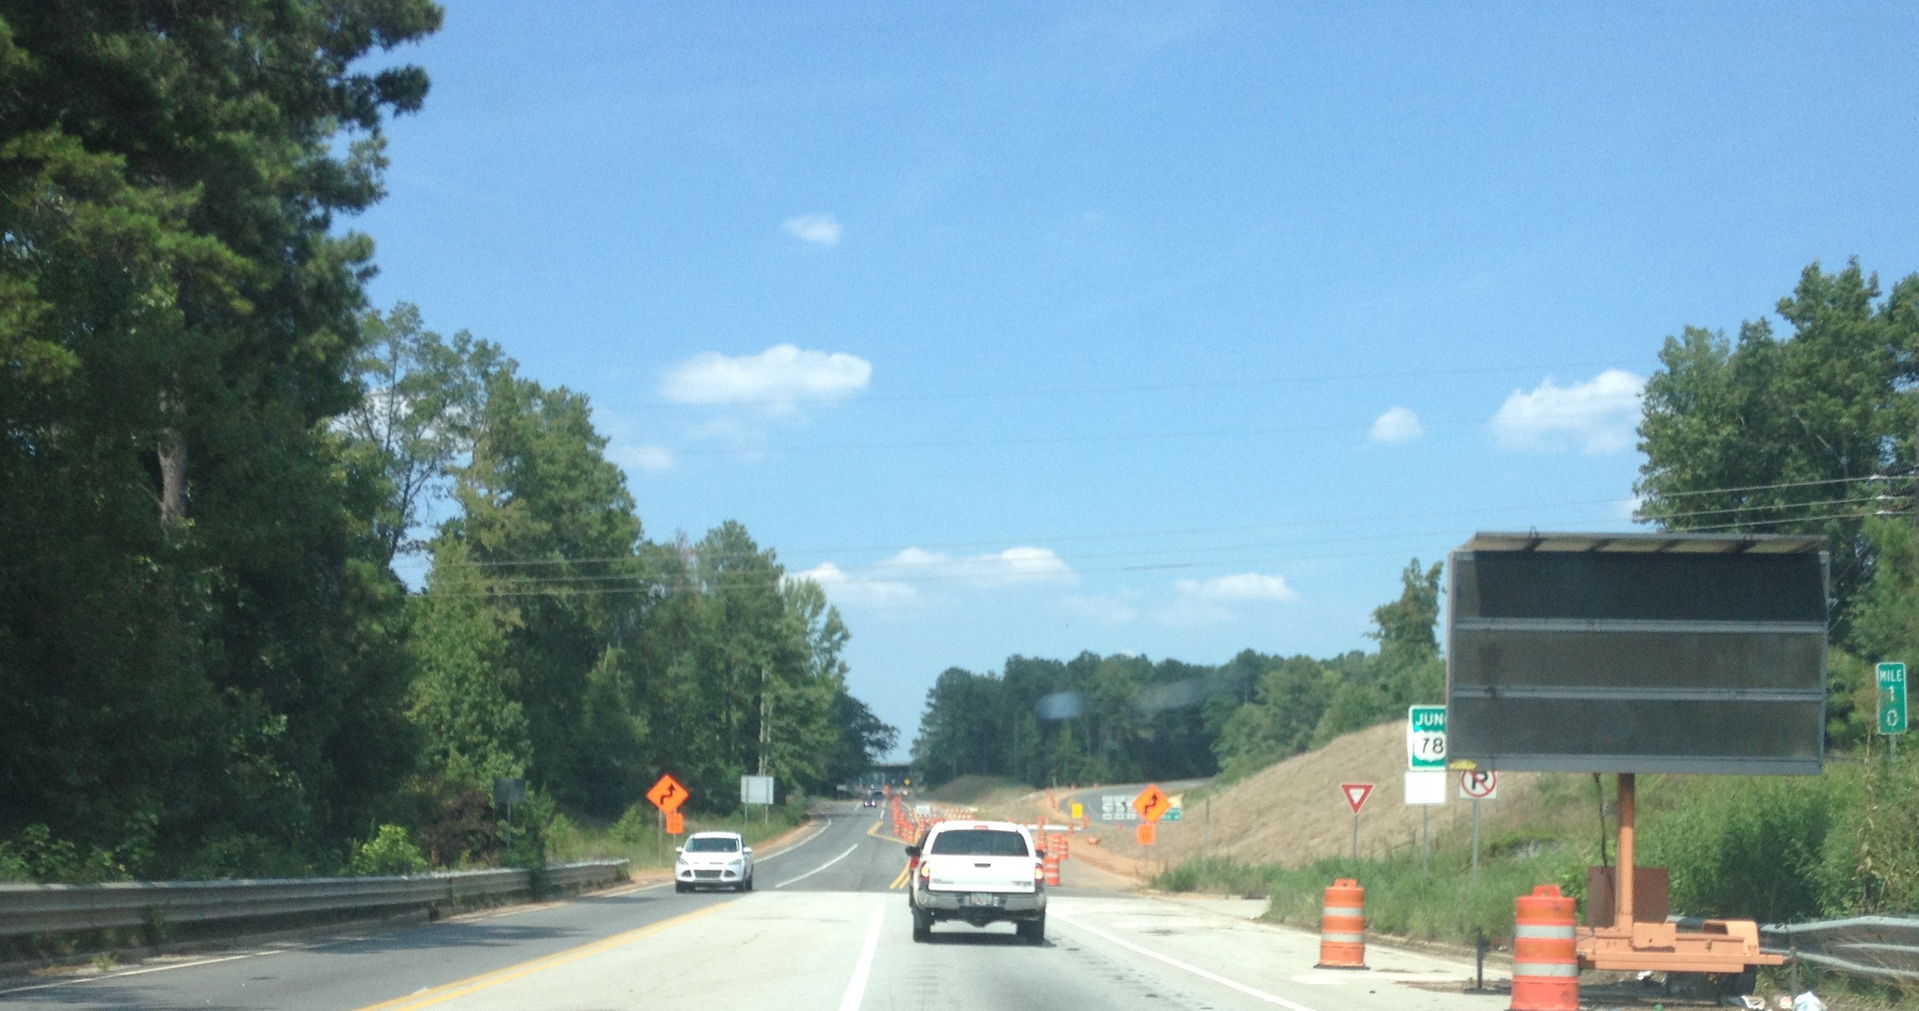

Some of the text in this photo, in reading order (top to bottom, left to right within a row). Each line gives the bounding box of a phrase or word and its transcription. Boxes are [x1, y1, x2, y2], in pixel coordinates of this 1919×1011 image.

[1879, 669, 1903, 682] MILE
[1415, 712, 1447, 727] JUN
[1422, 737, 1444, 754] 78
